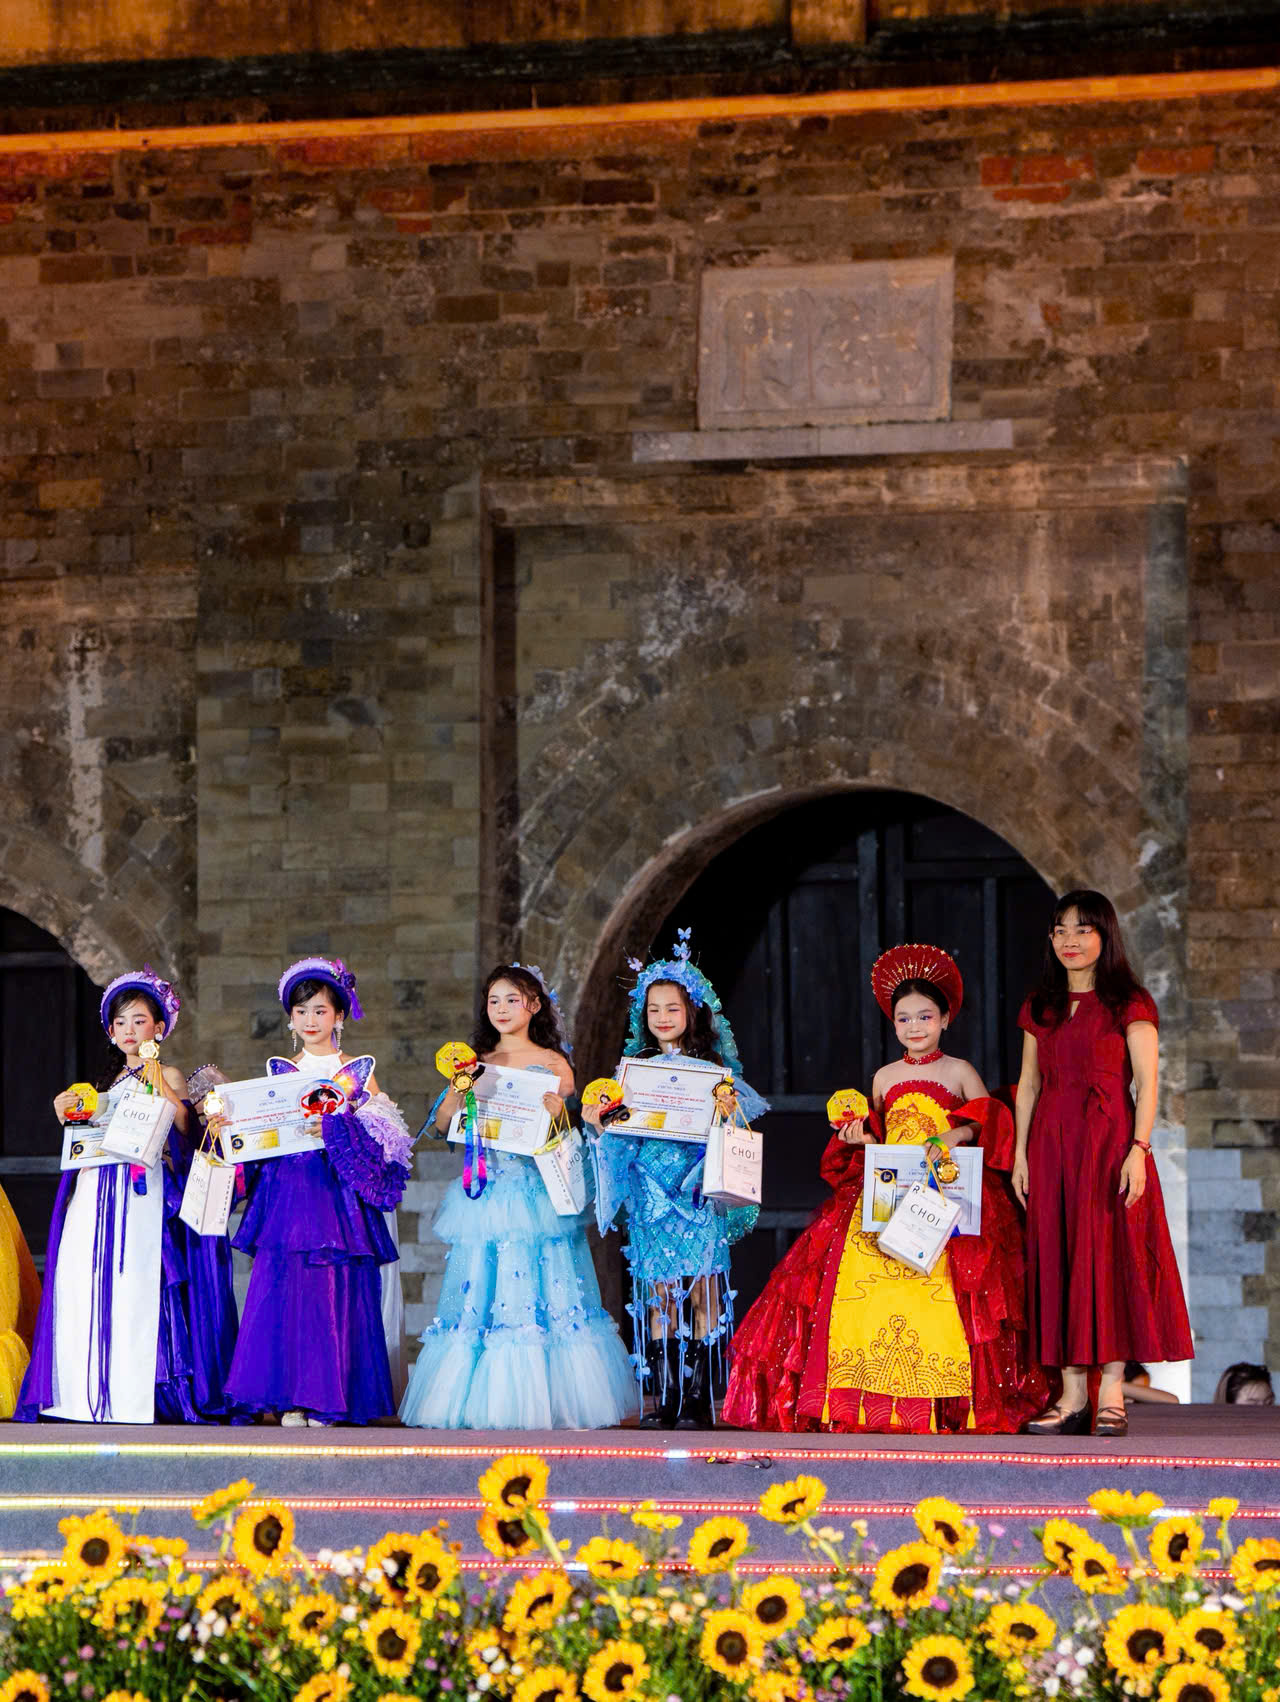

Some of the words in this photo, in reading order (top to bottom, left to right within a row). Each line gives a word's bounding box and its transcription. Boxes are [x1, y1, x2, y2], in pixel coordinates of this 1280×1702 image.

[123, 1109, 150, 1121] CHOI
[731, 1146, 755, 1160] CHOI
[910, 1203, 941, 1226] CHOI
